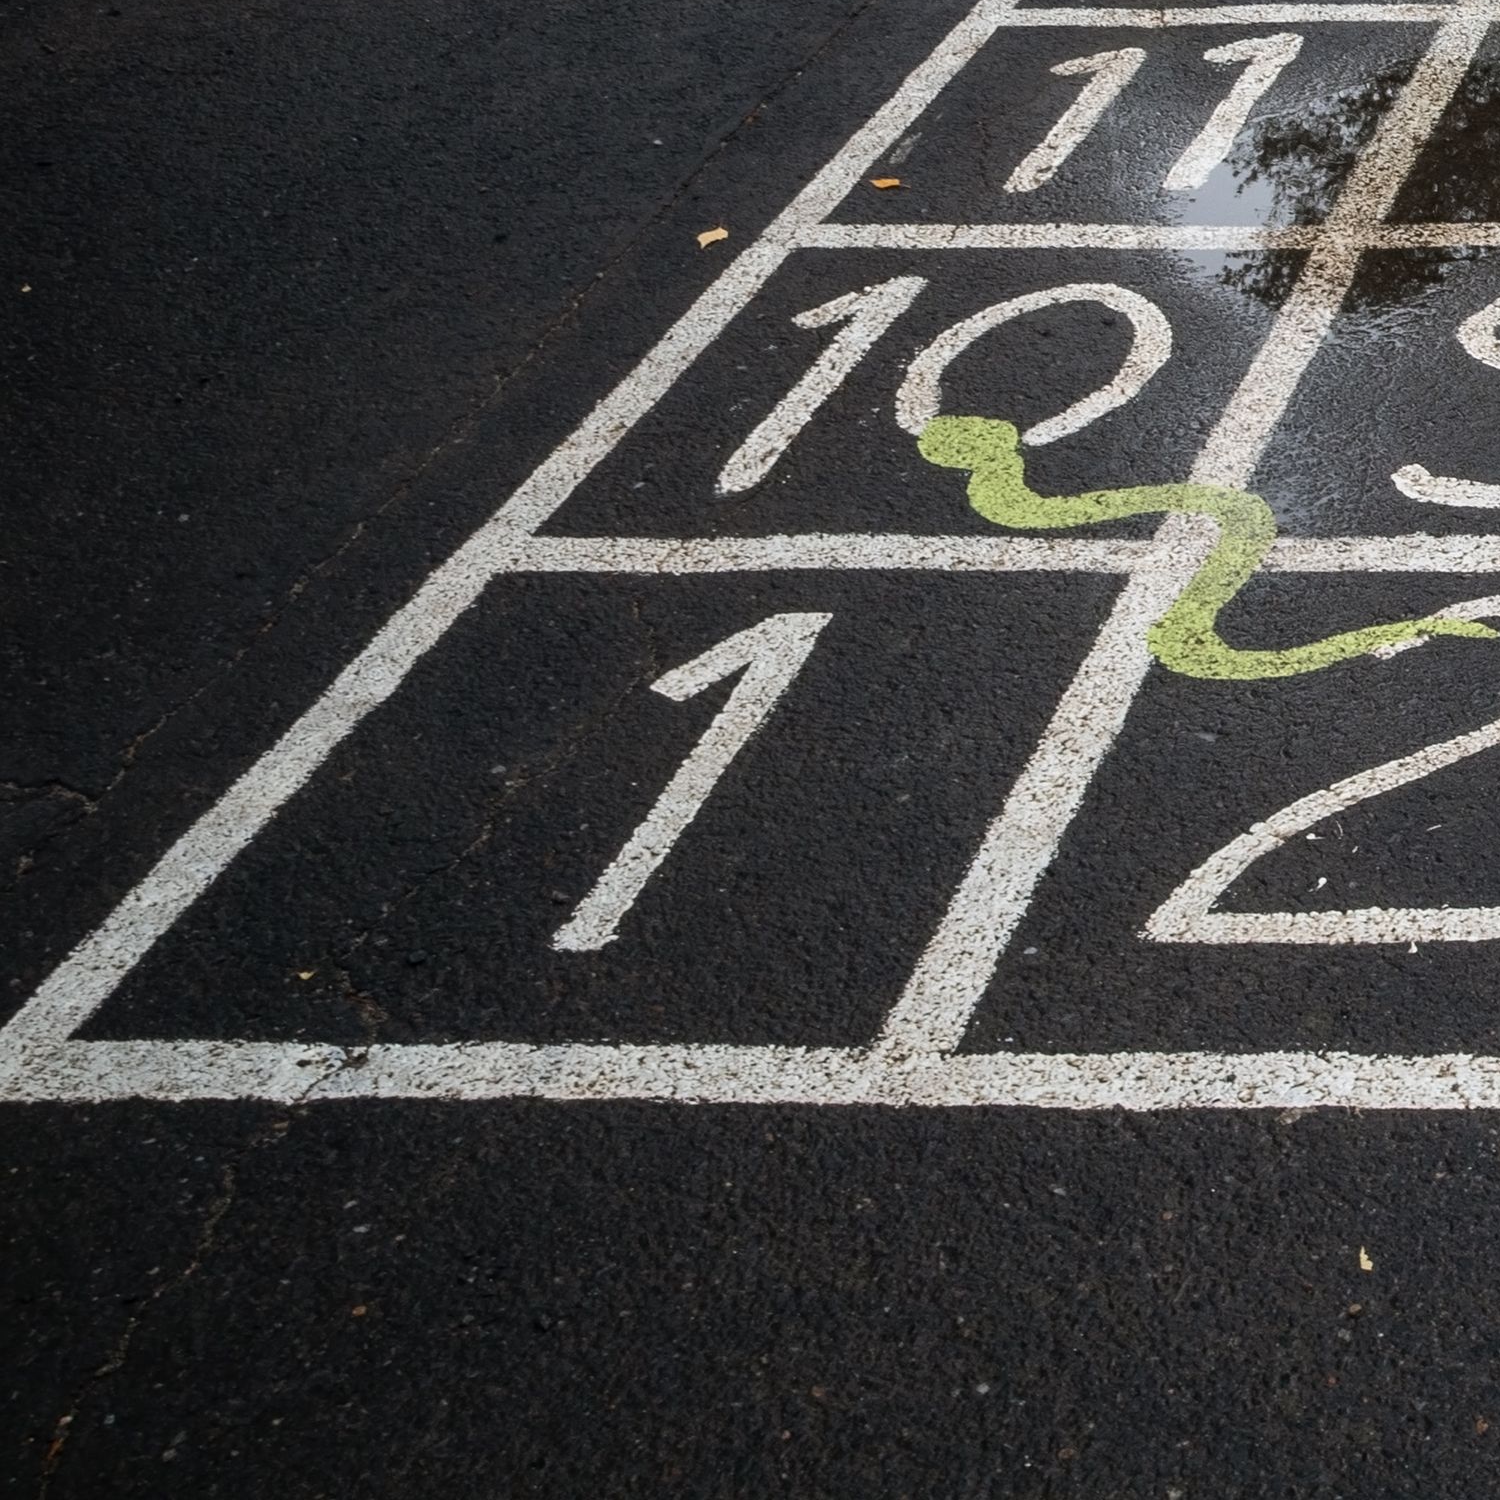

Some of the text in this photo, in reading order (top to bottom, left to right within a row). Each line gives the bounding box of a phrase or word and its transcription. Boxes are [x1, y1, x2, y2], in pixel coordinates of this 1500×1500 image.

[1002, 32, 1303, 194] 11
[715, 276, 1172, 496] 10
[552, 612, 832, 953] 1
